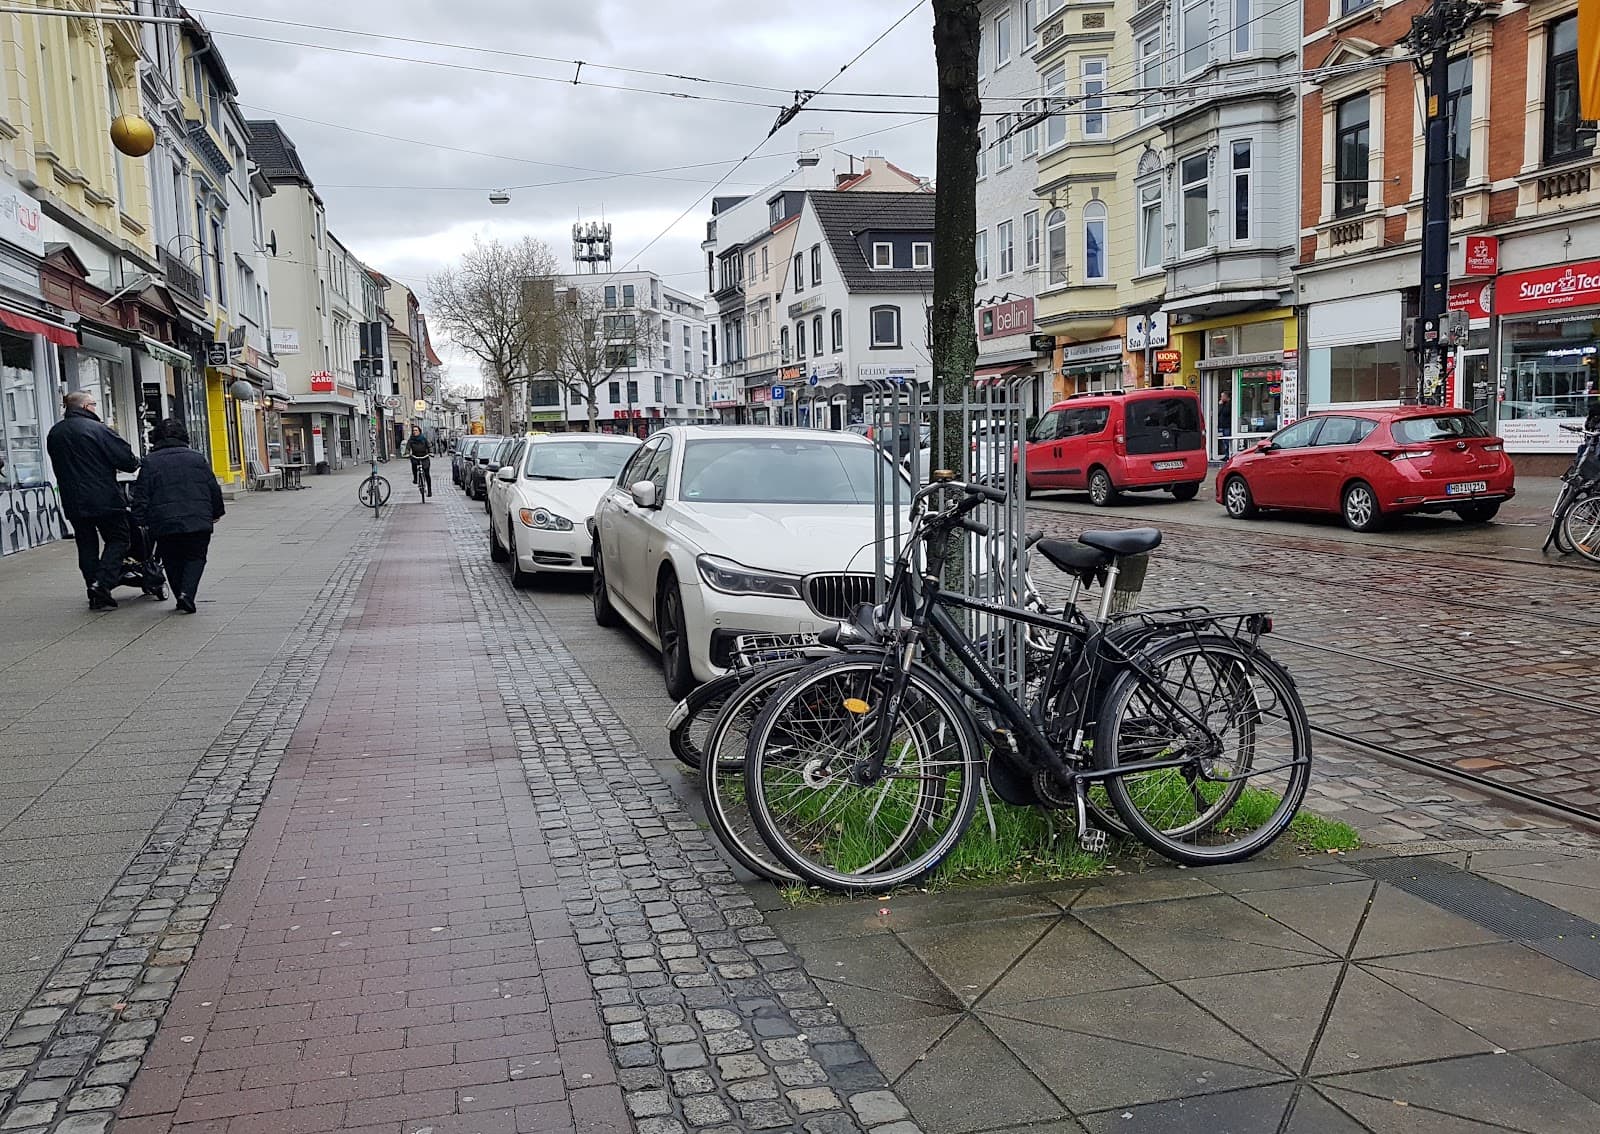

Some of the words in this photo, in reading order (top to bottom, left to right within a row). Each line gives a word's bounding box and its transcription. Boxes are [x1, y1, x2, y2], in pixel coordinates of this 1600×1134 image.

[1519, 281, 1557, 298] Super
[1547, 295, 1575, 304] Computer
[996, 304, 1028, 331] bellini
[1129, 337, 1141, 349] Sea
[1157, 352, 1178, 360] KIOSK
[775, 388, 782, 398] P
[614, 409, 642, 419] REWE
